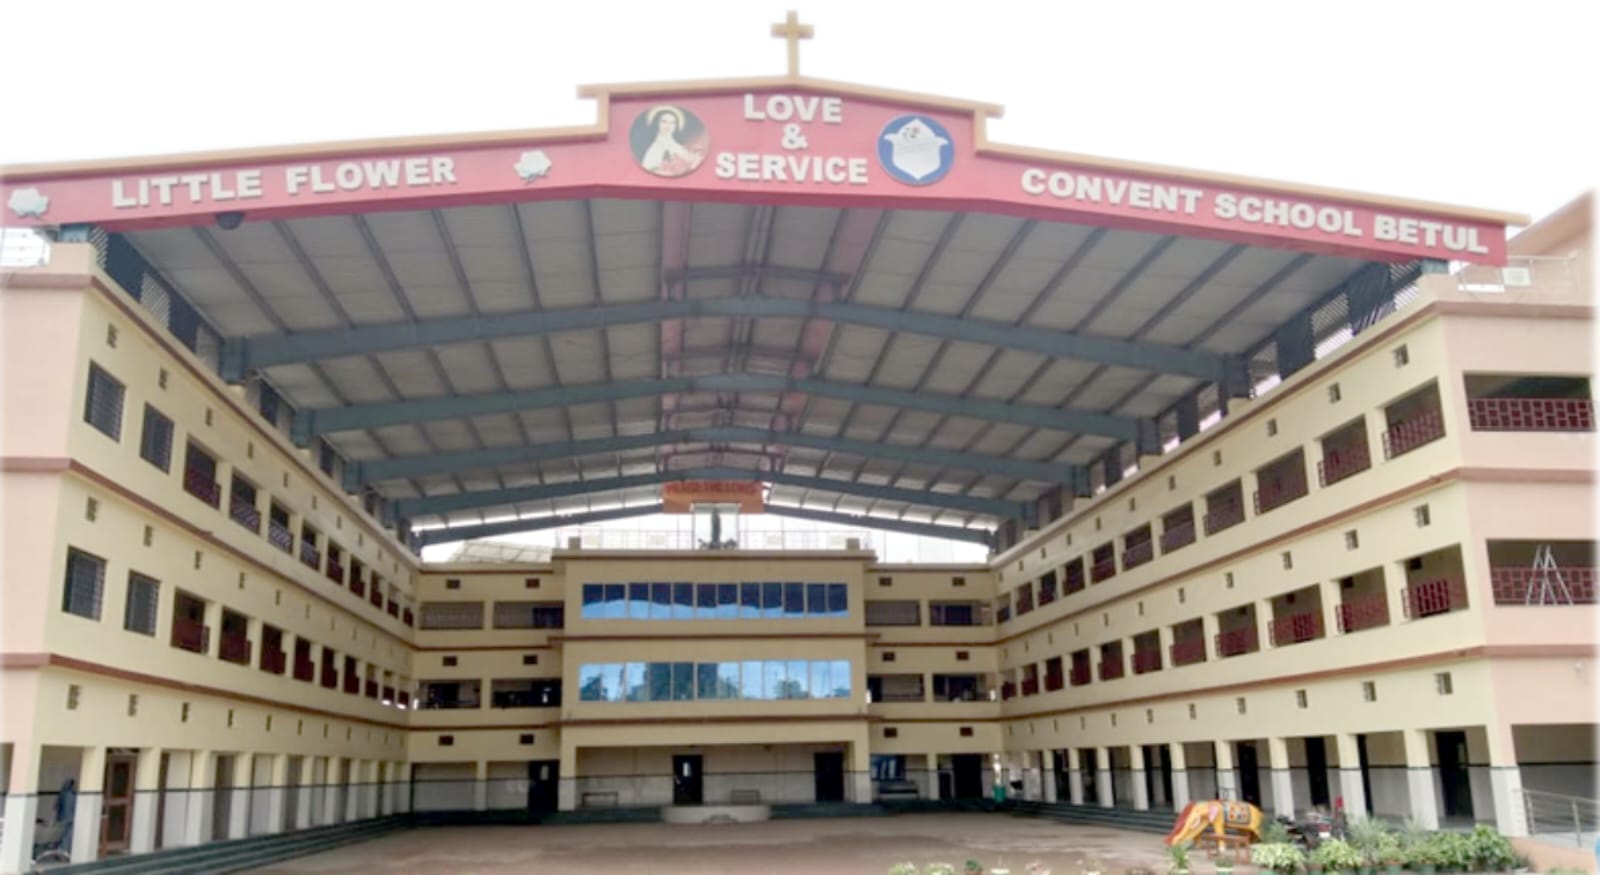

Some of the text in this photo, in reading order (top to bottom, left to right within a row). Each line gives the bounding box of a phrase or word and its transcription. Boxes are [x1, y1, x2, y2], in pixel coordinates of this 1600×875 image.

[743, 94, 842, 122] LOVE
[781, 123, 808, 150] &
[111, 156, 457, 208] LITTLE FLOWER
[715, 152, 869, 184] SERVICE
[1021, 168, 1488, 254] CONVENT SCHOOL BETUL
